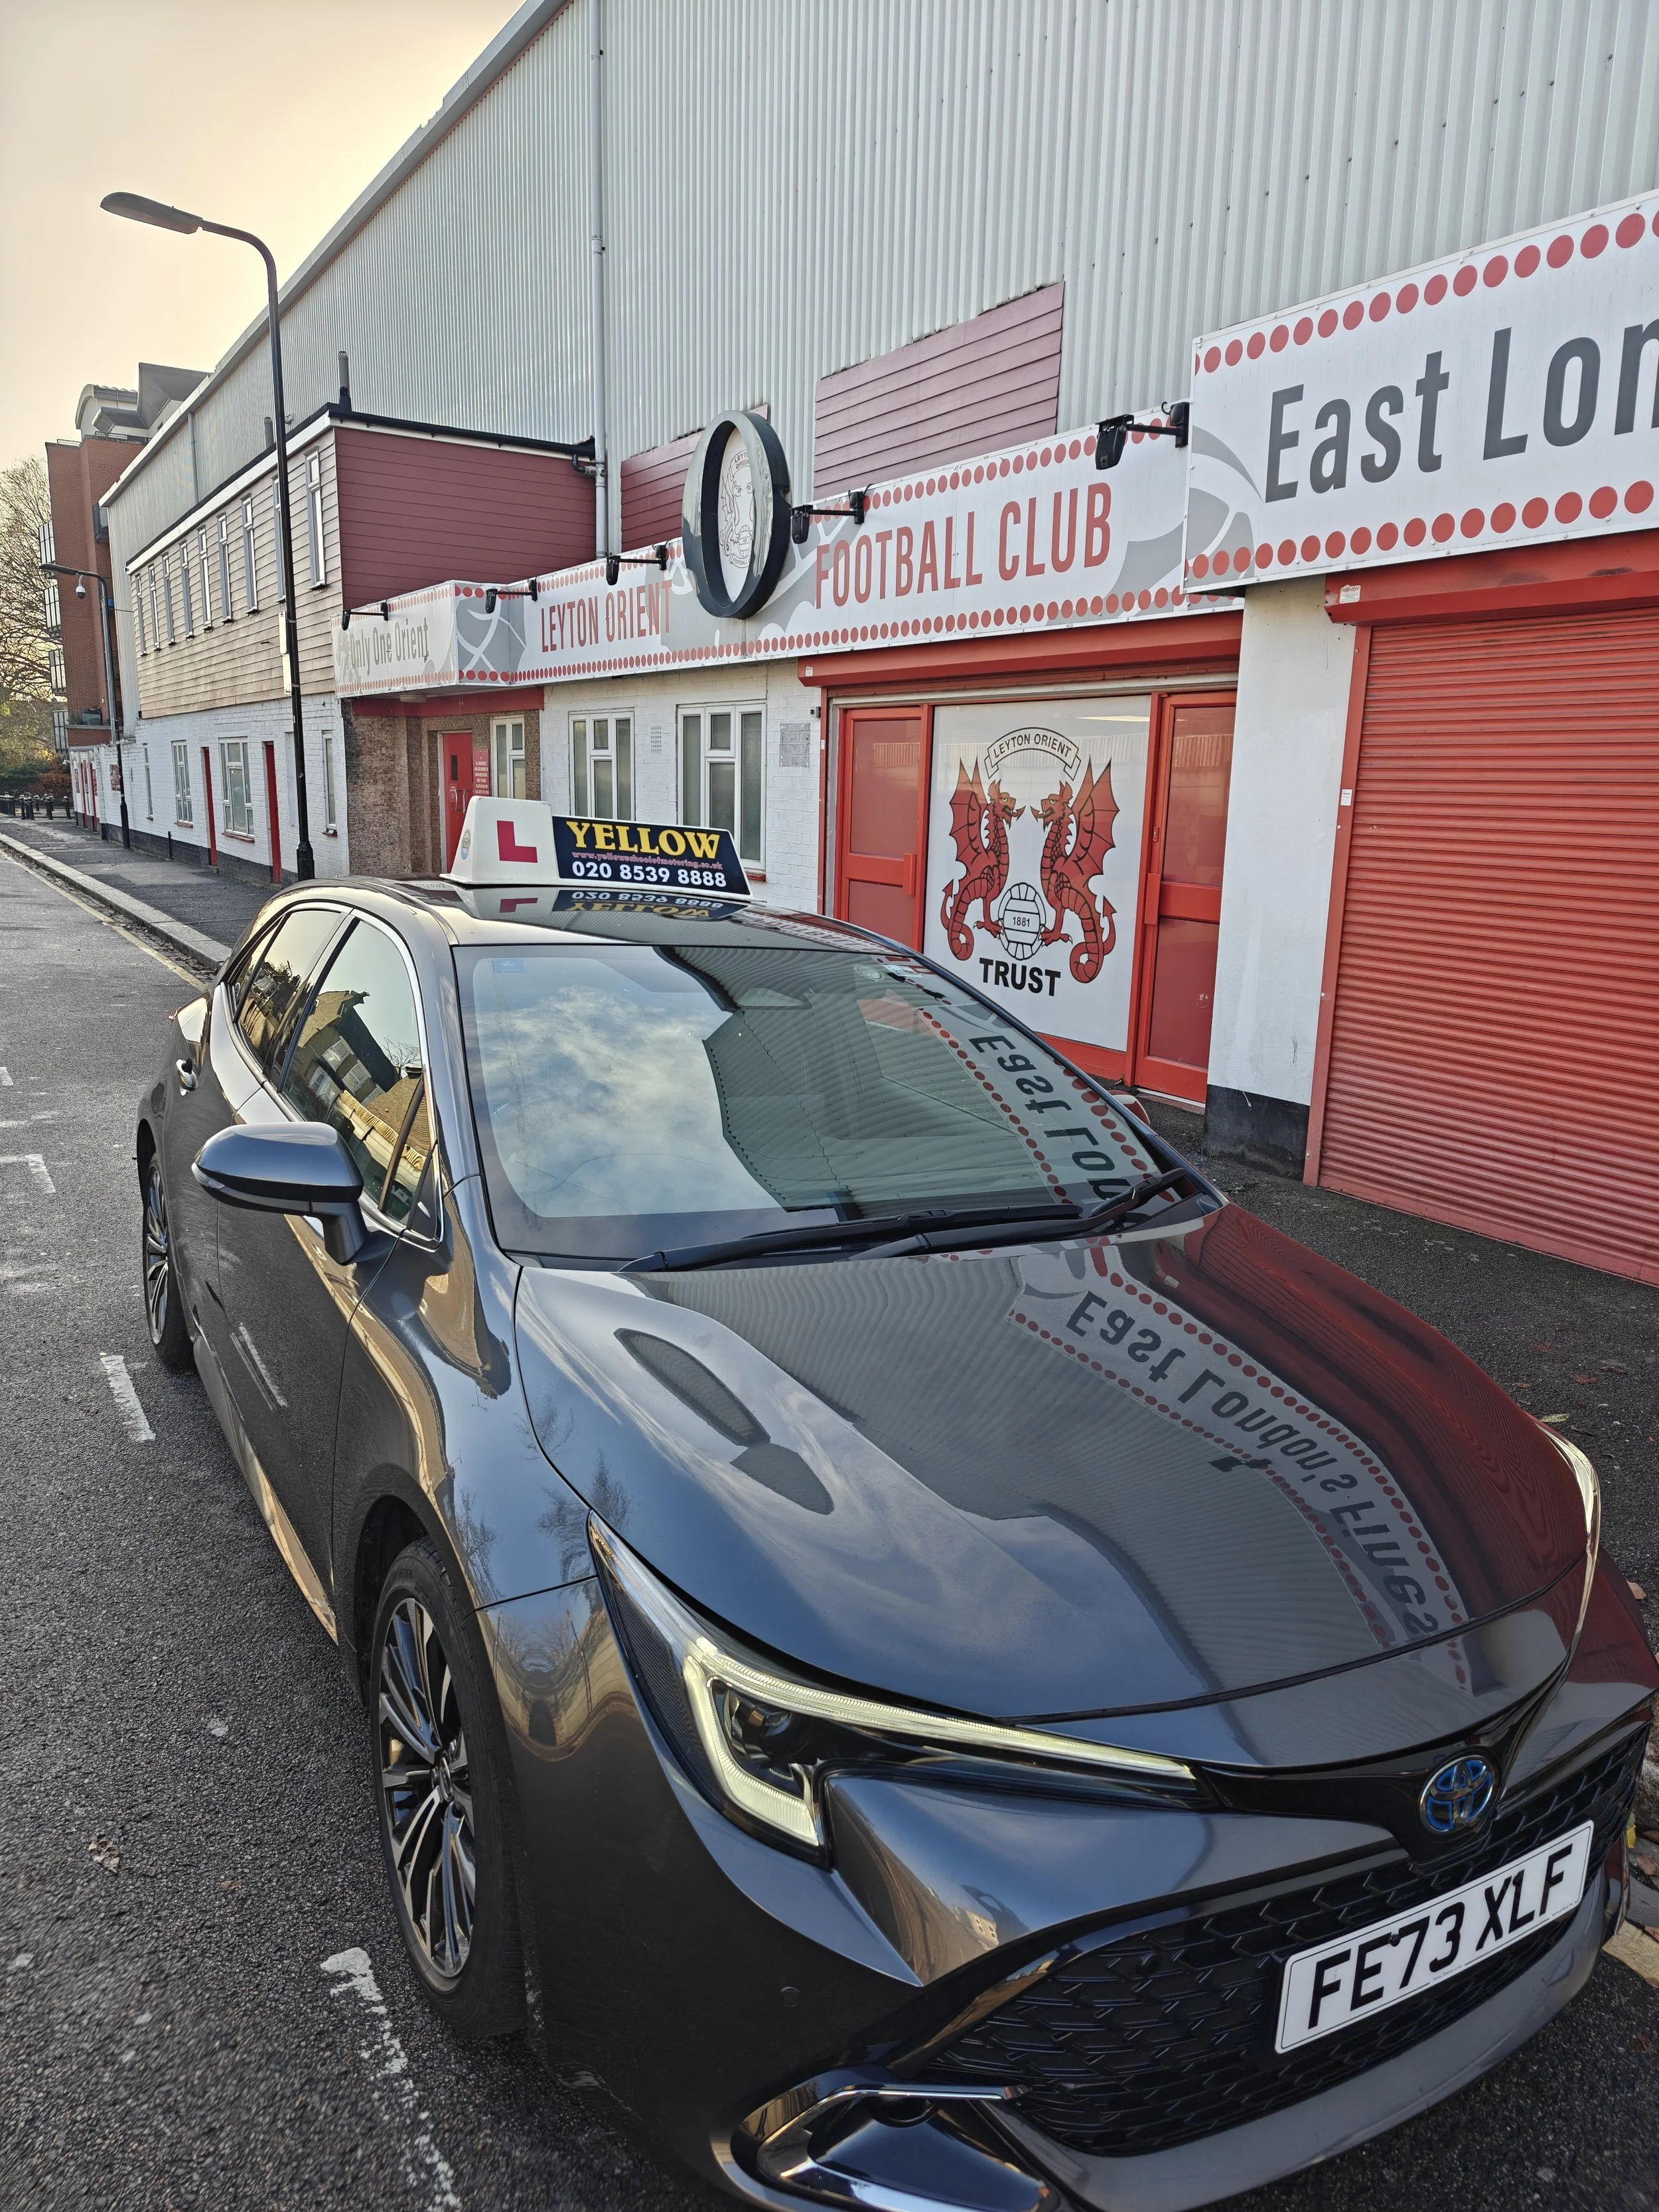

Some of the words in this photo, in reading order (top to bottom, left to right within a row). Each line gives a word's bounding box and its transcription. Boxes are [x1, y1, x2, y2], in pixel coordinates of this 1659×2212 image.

[1264, 350, 1450, 504] East
[734, 452, 749, 463] LEYT
[816, 511, 983, 609] FOOTBALL
[998, 482, 1112, 581] CLUB
[541, 595, 600, 653] LEYTON
[605, 579, 672, 642] ORIENT
[350, 628, 371, 676] Only
[373, 627, 393, 665] One
[395, 617, 429, 662] Orient
[993, 733, 1031, 759] LEYTON
[1034, 733, 1072, 758] ORIENT
[496, 820, 538, 863] L
[566, 820, 721, 859] YELLOW
[571, 851, 723, 869] www.yellowschoolofmotoring.co.uk
[572, 861, 612, 879] 020
[619, 864, 670, 883] 8539
[678, 869, 727, 887] 8888
[1012, 915, 1031, 928] 1881
[979, 958, 1061, 997] TRUST
[1307, 1901, 1465, 2030] FE73
[1477, 1843, 1574, 1952] XLF
